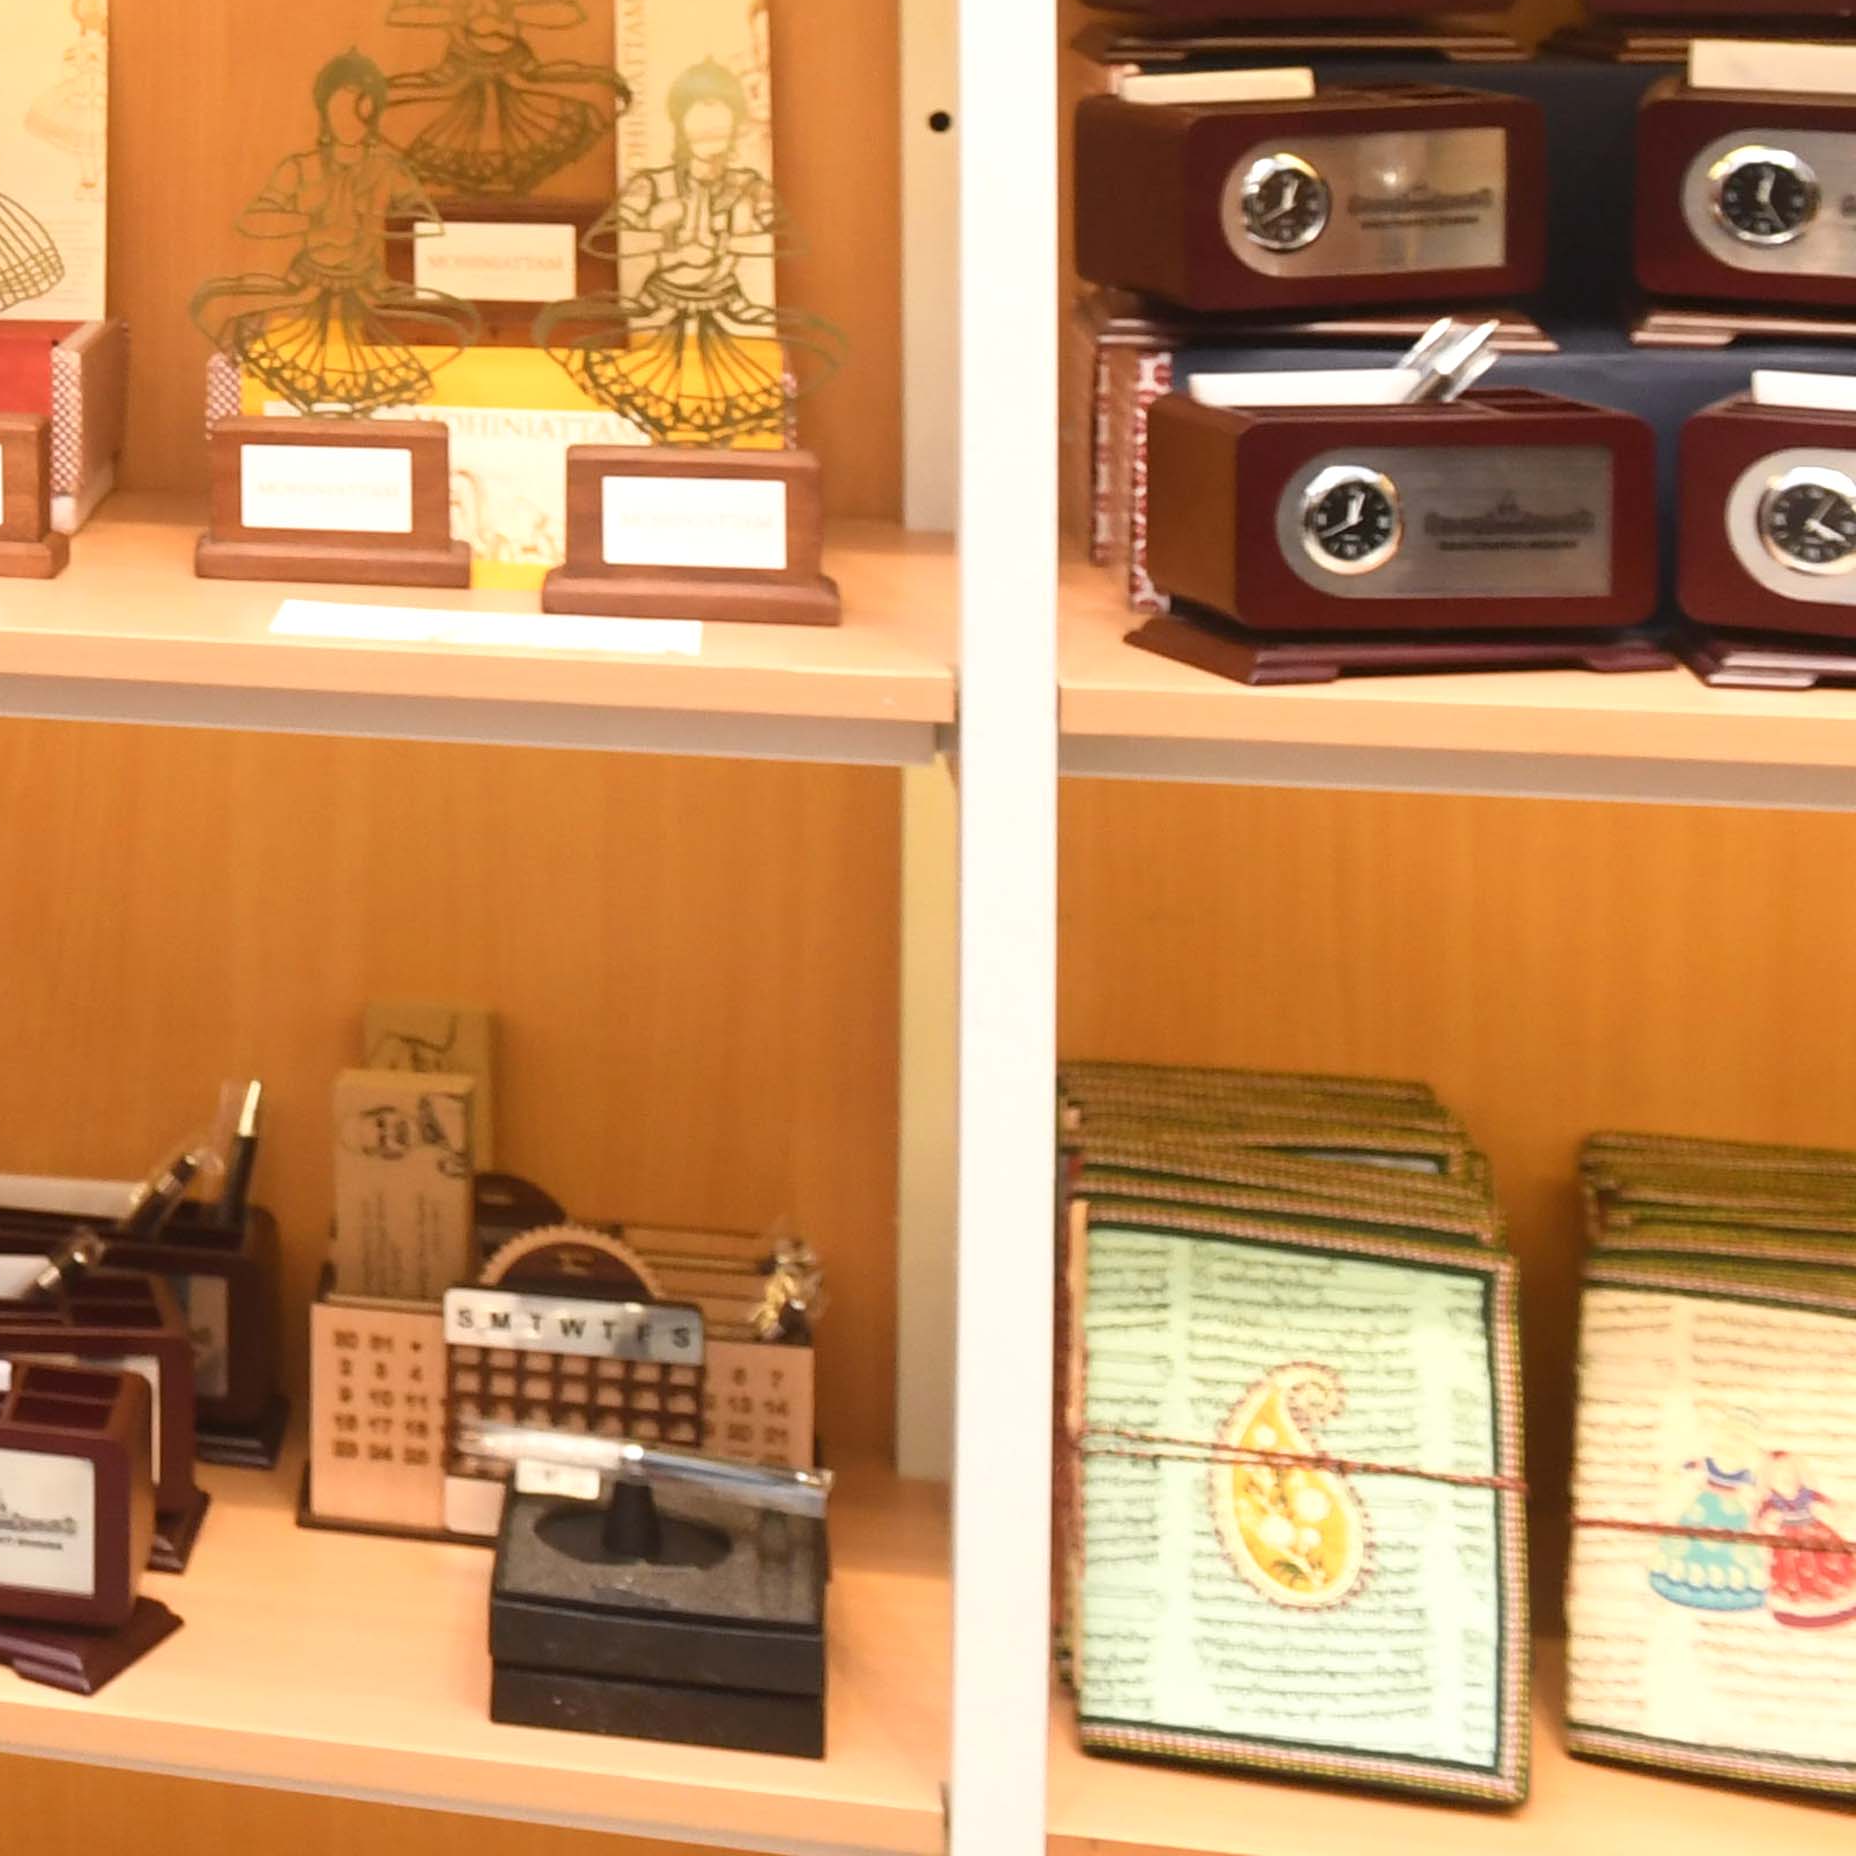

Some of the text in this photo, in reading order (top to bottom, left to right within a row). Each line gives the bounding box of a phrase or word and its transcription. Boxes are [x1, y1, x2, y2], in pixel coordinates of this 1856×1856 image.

[459, 1310, 688, 1347] S M T W T F S
